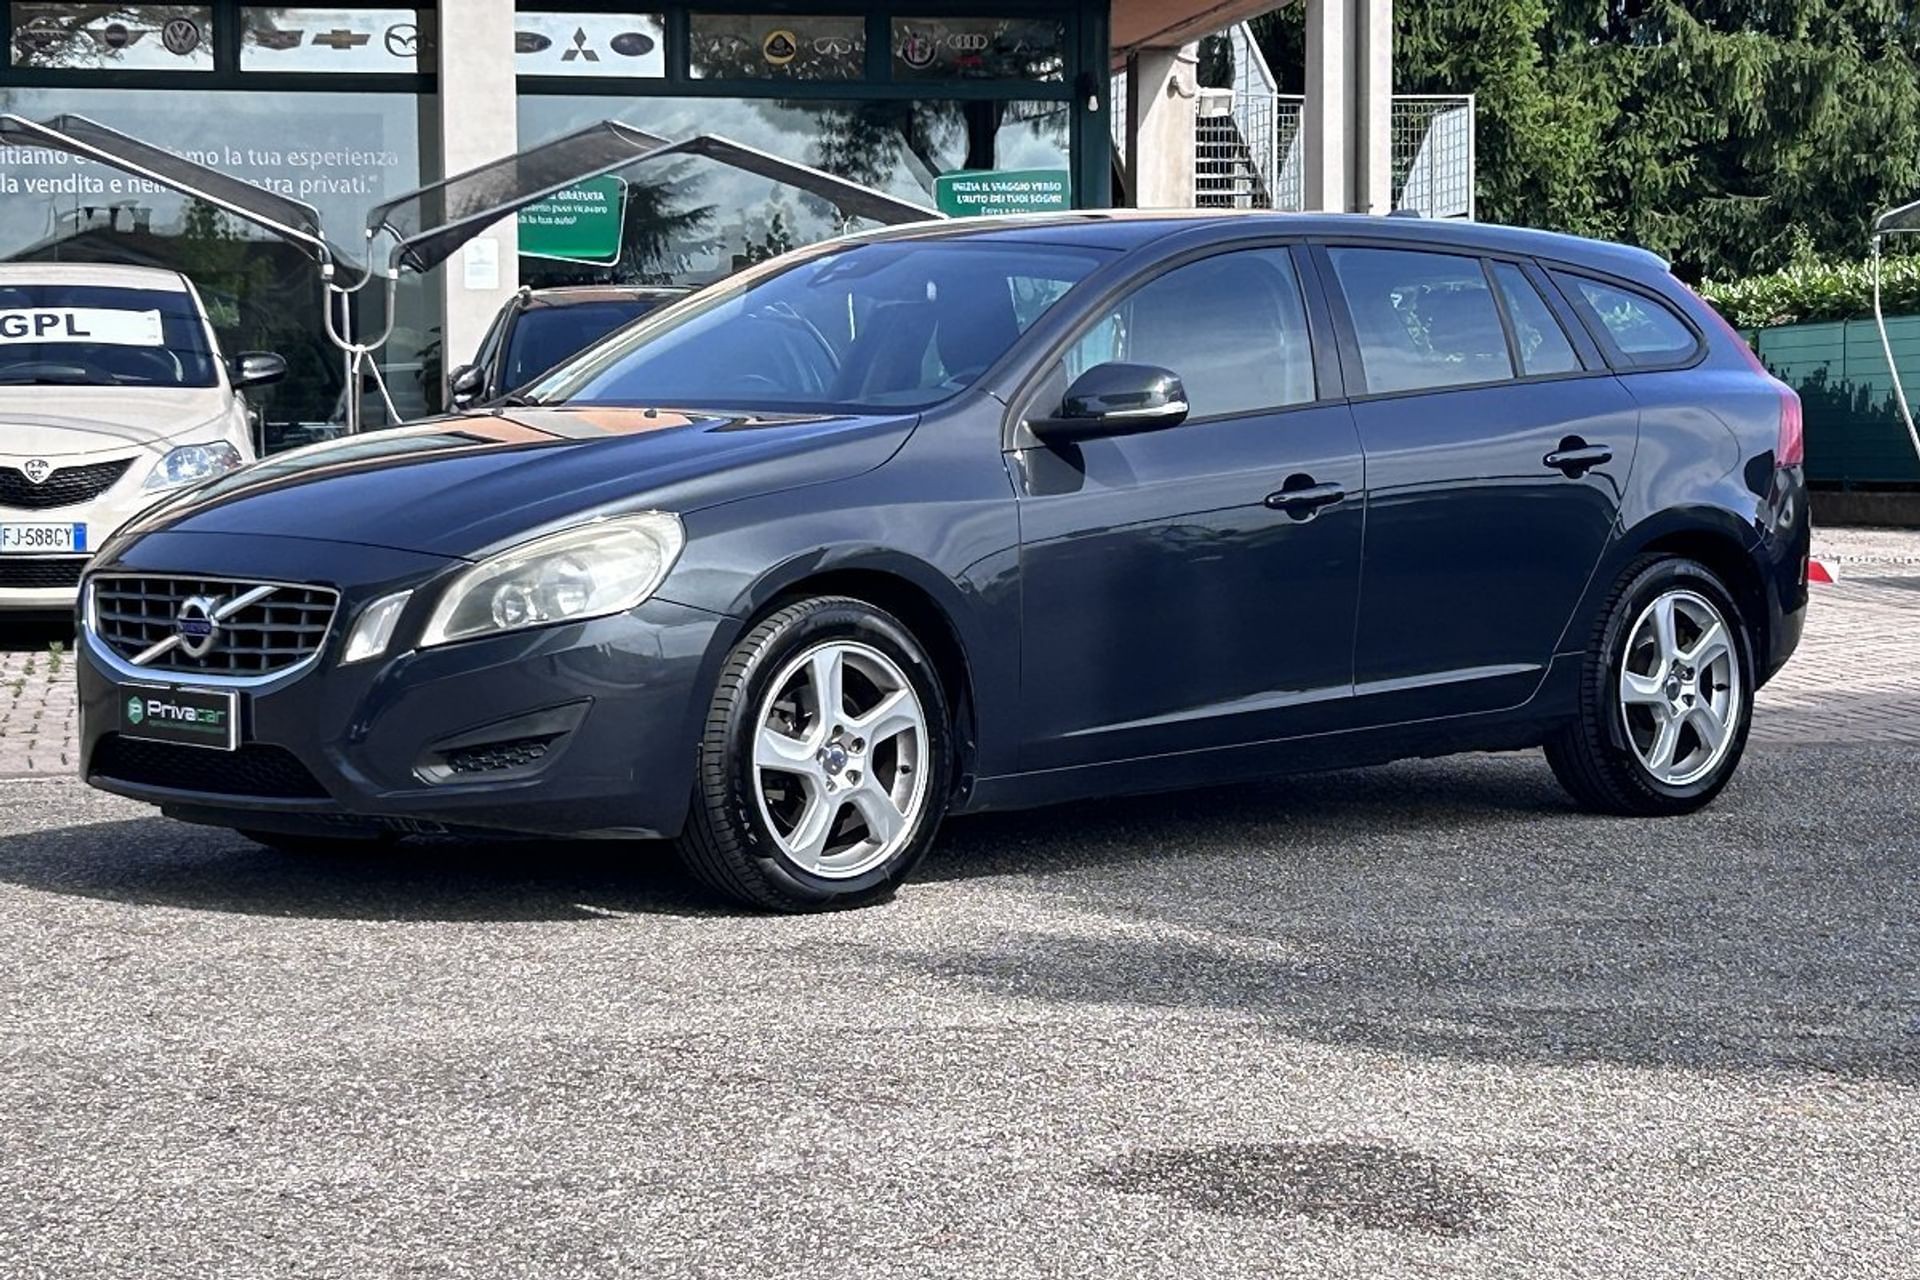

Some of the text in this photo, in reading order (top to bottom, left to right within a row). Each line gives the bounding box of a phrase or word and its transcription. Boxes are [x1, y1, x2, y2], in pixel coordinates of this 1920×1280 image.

[225, 146, 242, 165] la
[248, 149, 281, 166] tua
[287, 147, 398, 170] esperienza
[24, 173, 104, 194] vendita
[110, 179, 122, 194] e
[991, 182, 1029, 191] VIAGGIO
[1031, 181, 1062, 192] VERSO
[0, 313, 91, 338] GPL
[147, 698, 225, 724] Privacar
